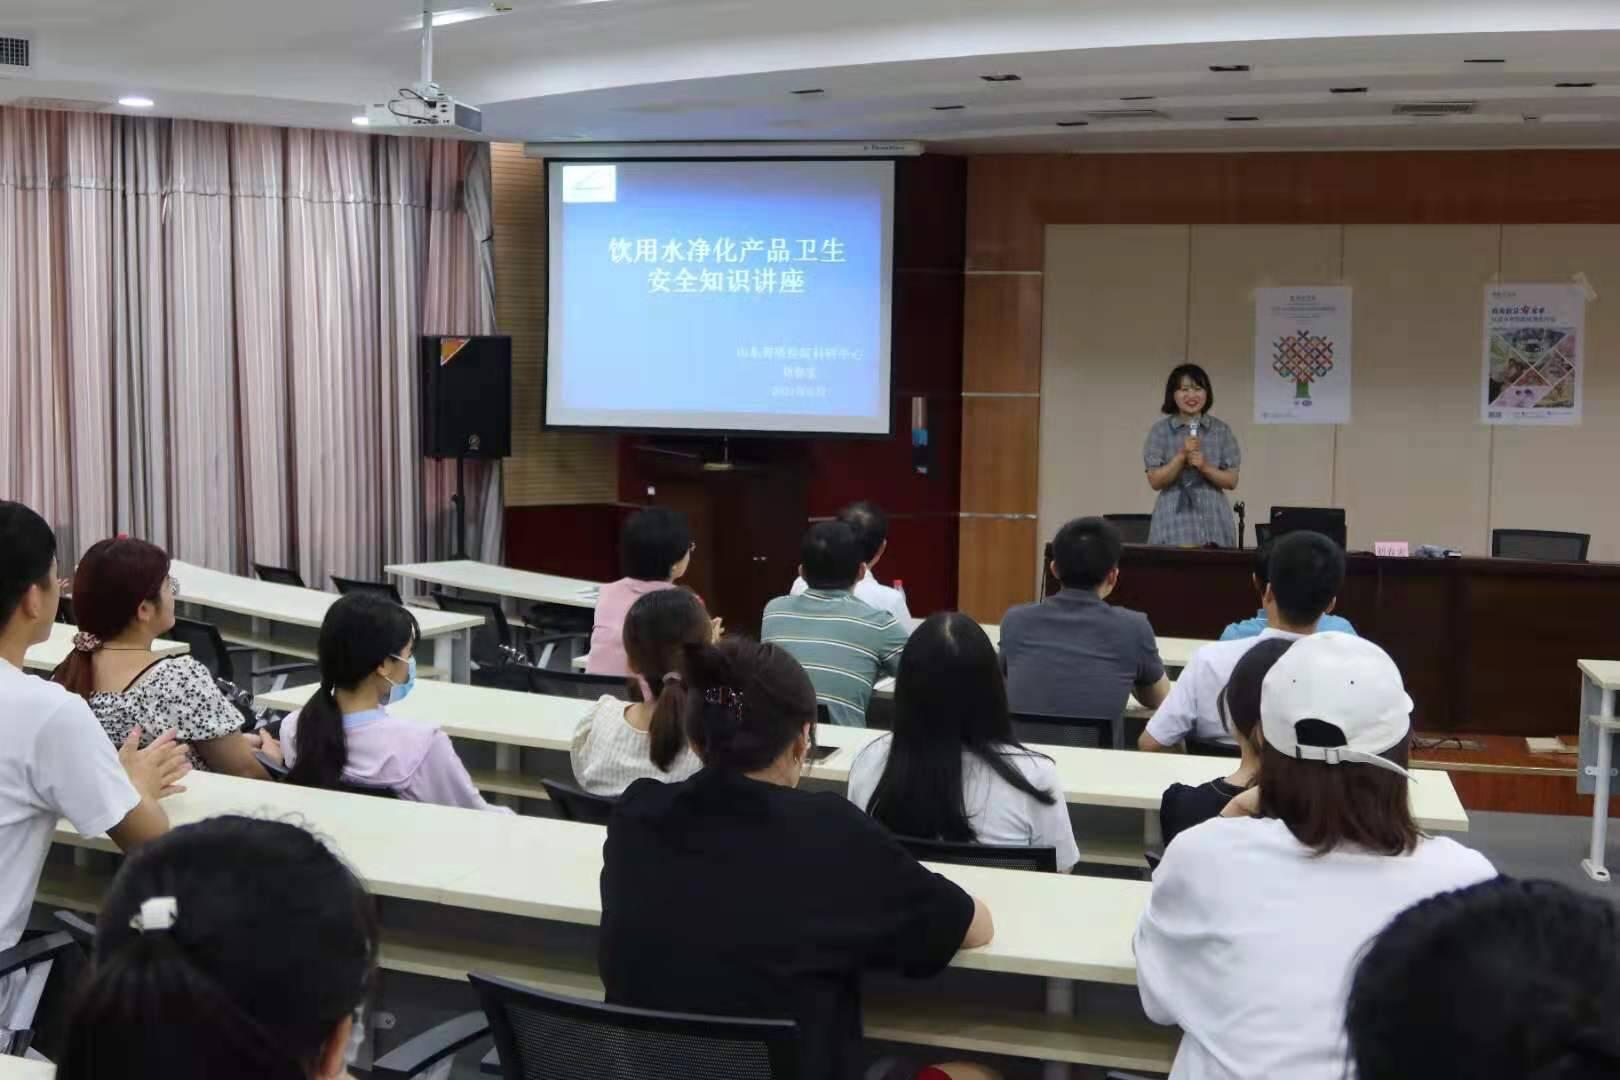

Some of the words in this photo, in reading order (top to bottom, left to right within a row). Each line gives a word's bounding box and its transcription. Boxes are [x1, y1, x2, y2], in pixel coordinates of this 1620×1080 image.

[608, 236, 847, 265] 饮用水净化产品卫生
[647, 267, 806, 296] 安全知识讲座
